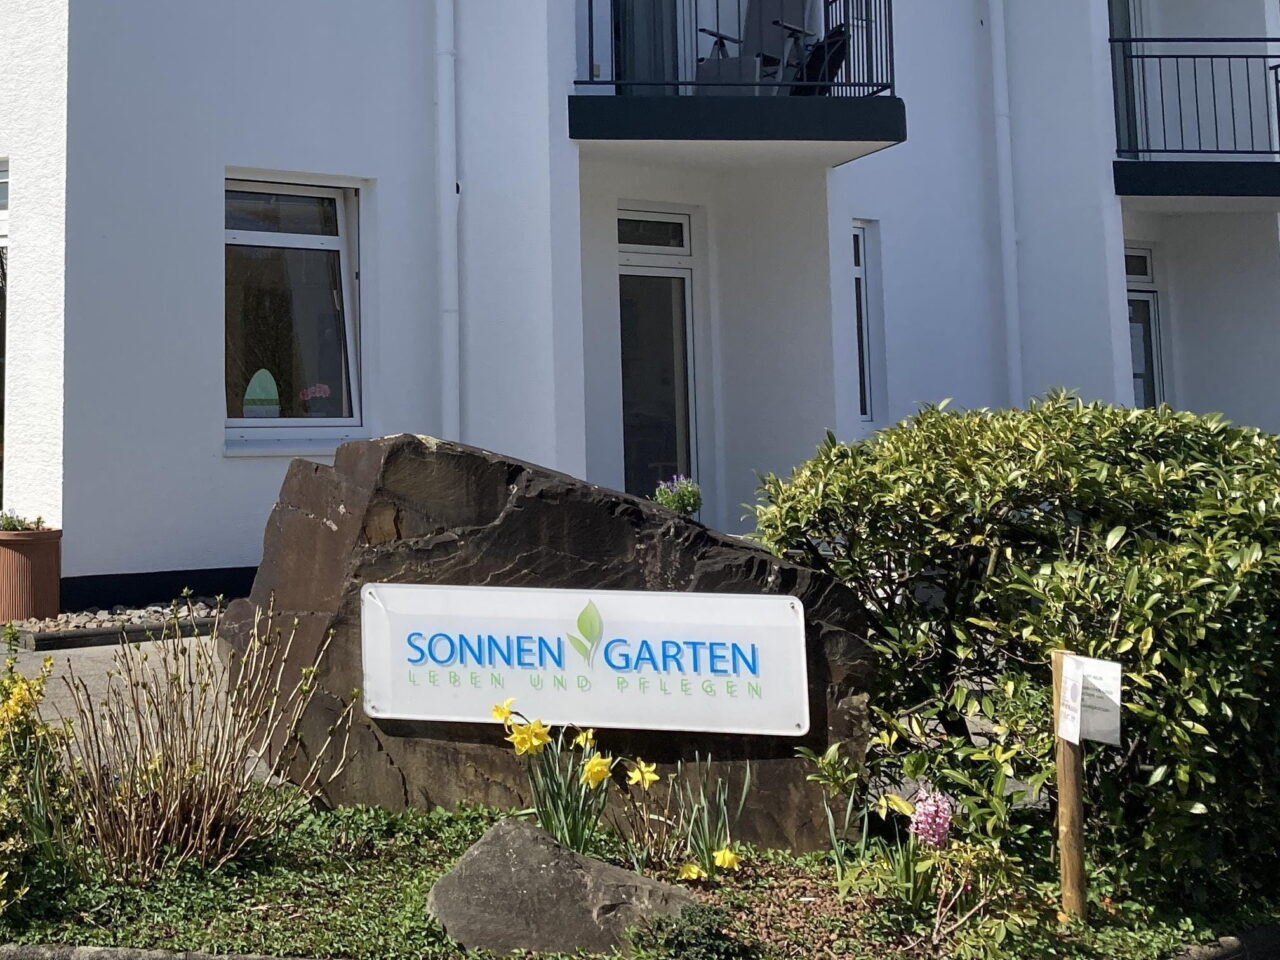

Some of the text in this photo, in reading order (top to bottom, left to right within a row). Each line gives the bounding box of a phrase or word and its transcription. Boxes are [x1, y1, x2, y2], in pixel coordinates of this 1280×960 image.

[407, 632, 758, 675] SONNEN GARTEN
[408, 670, 761, 697] LEBEN UND PFLEGEN
